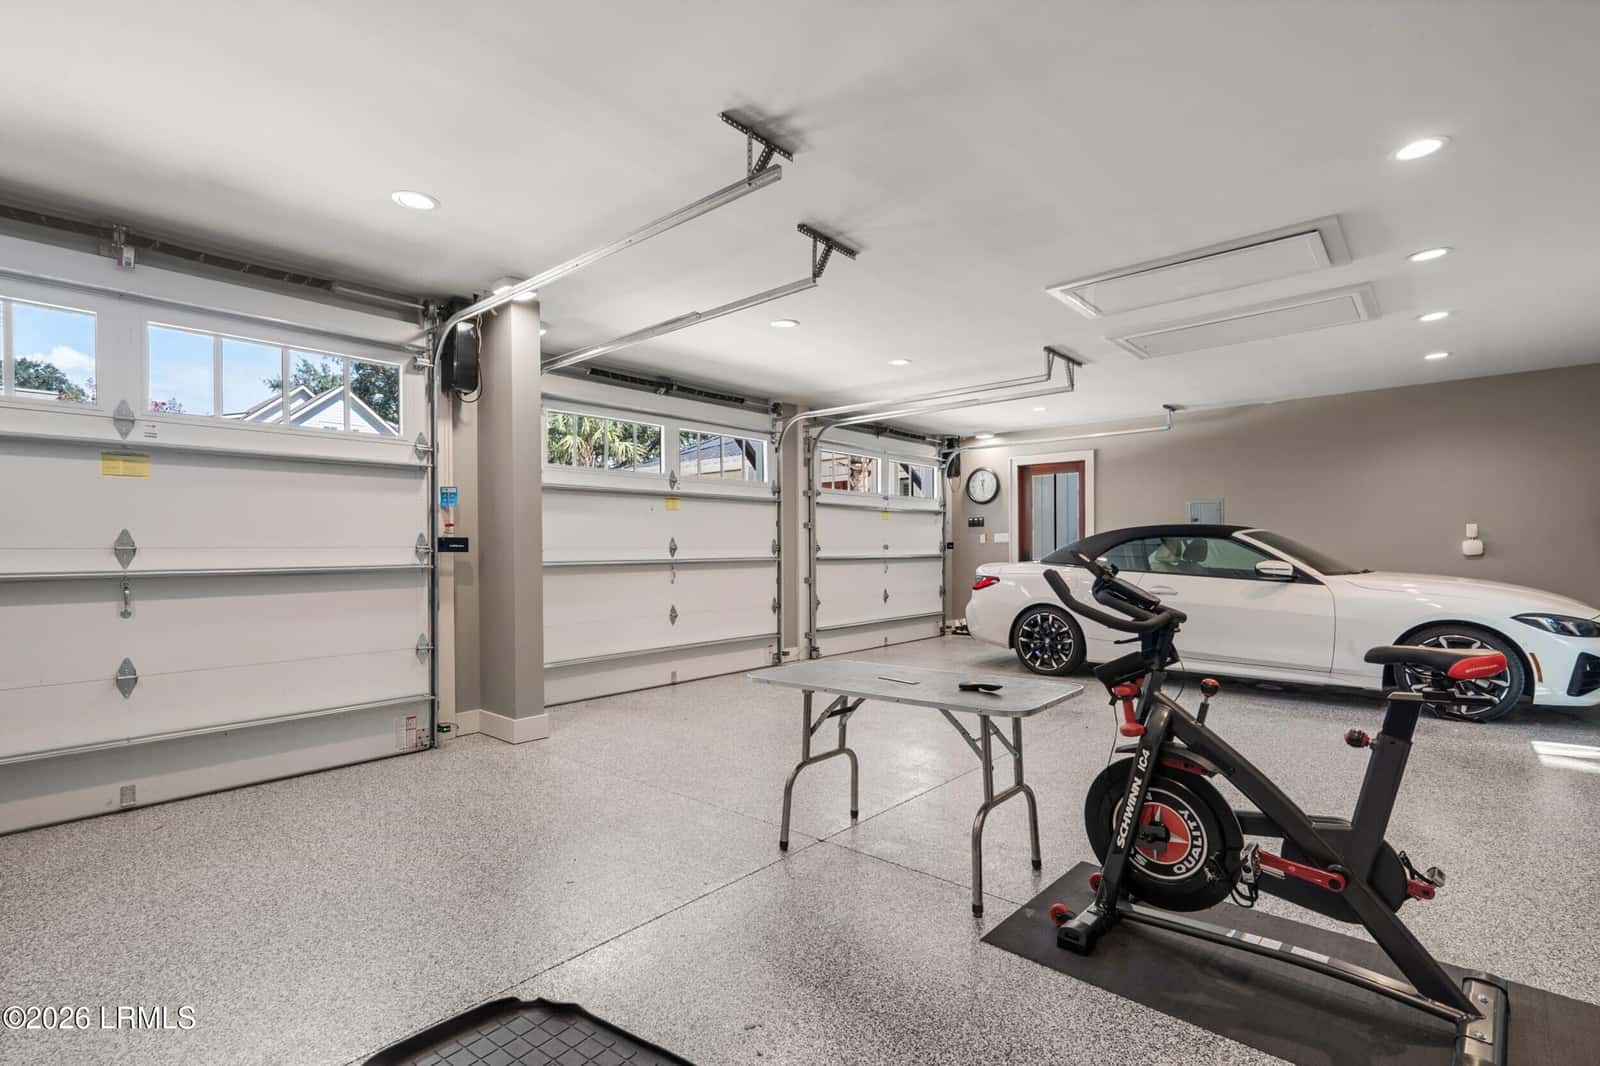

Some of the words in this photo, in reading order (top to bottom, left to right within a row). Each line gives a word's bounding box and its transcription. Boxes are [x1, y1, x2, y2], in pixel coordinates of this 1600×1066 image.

[1116, 777, 1142, 849] SCHWINN
[1137, 748, 1150, 772] IC4
[1173, 808, 1203, 874] QUALITY
